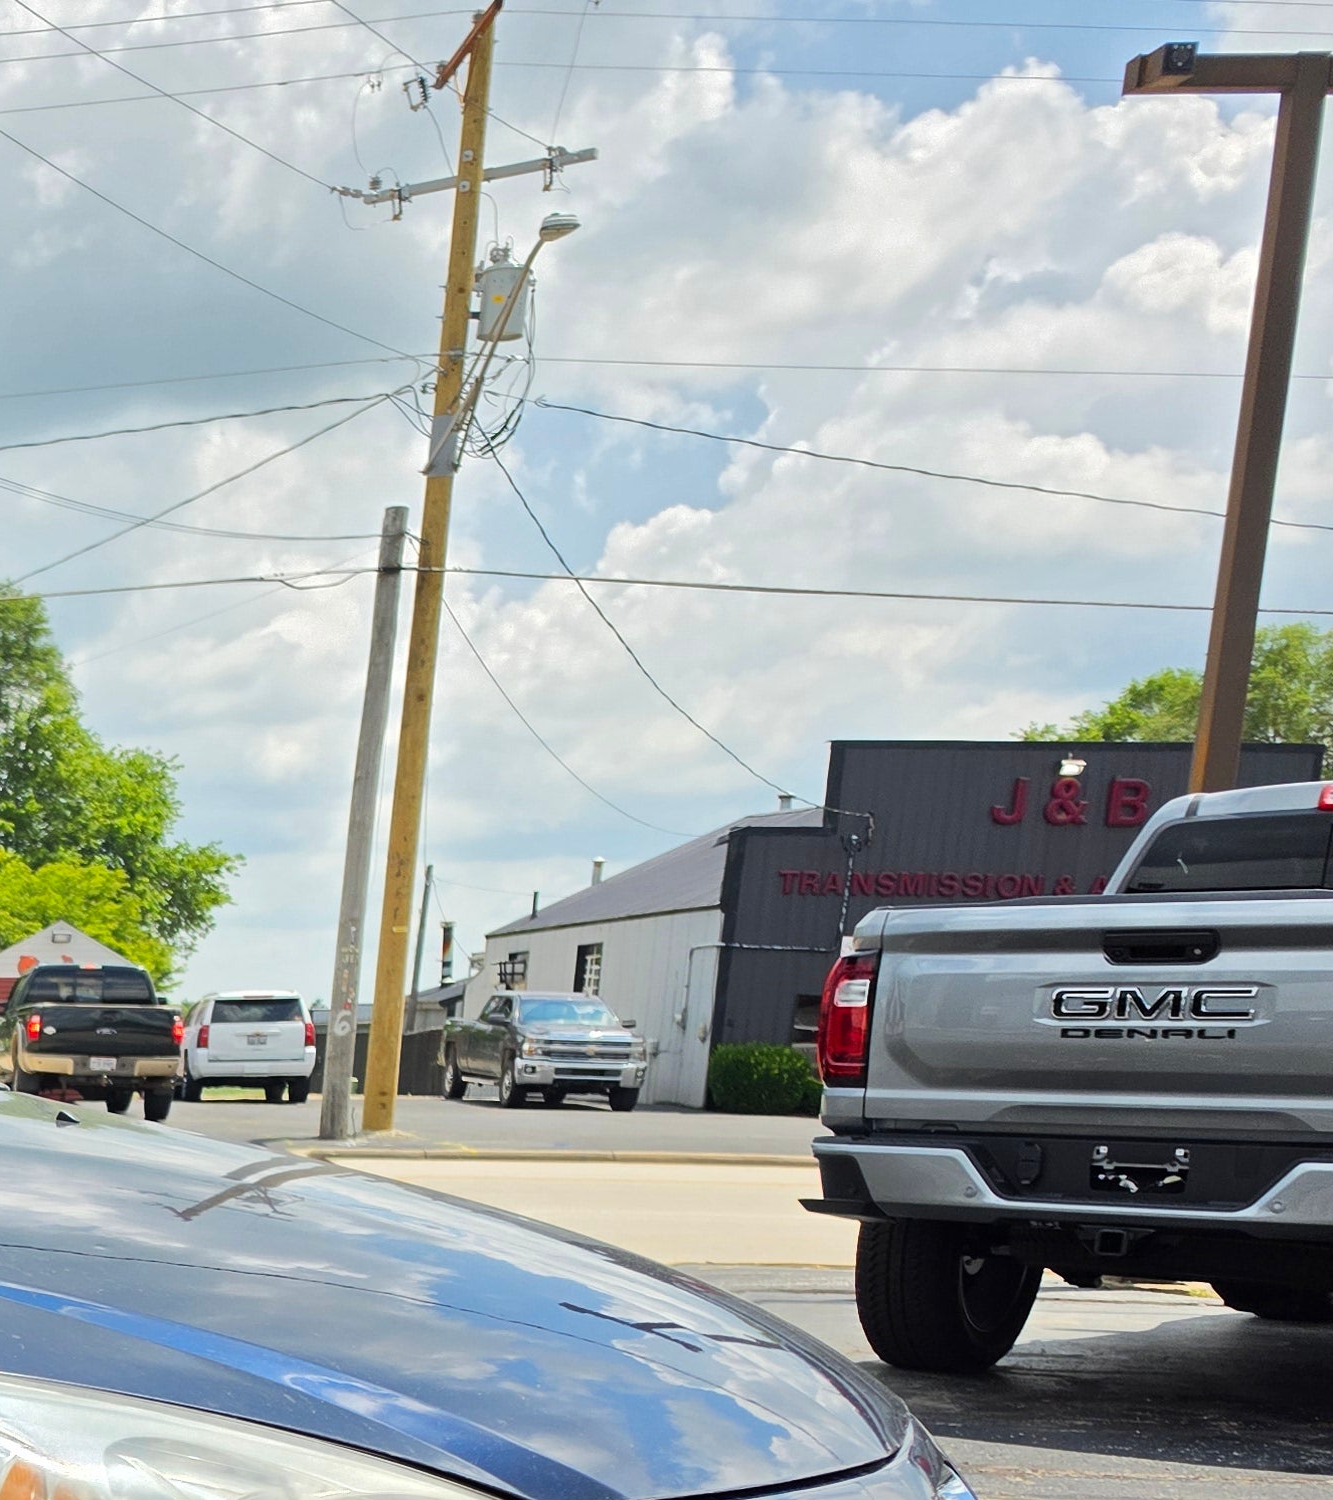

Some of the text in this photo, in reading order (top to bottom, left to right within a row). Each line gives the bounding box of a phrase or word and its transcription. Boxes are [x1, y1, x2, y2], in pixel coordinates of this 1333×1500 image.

[991, 776, 1152, 828] J & B
[778, 869, 1045, 899] TRANSMISSION
[1052, 874, 1077, 897] &
[1051, 986, 1260, 1020] GMC
[1060, 1027, 1237, 1040] DENALI
